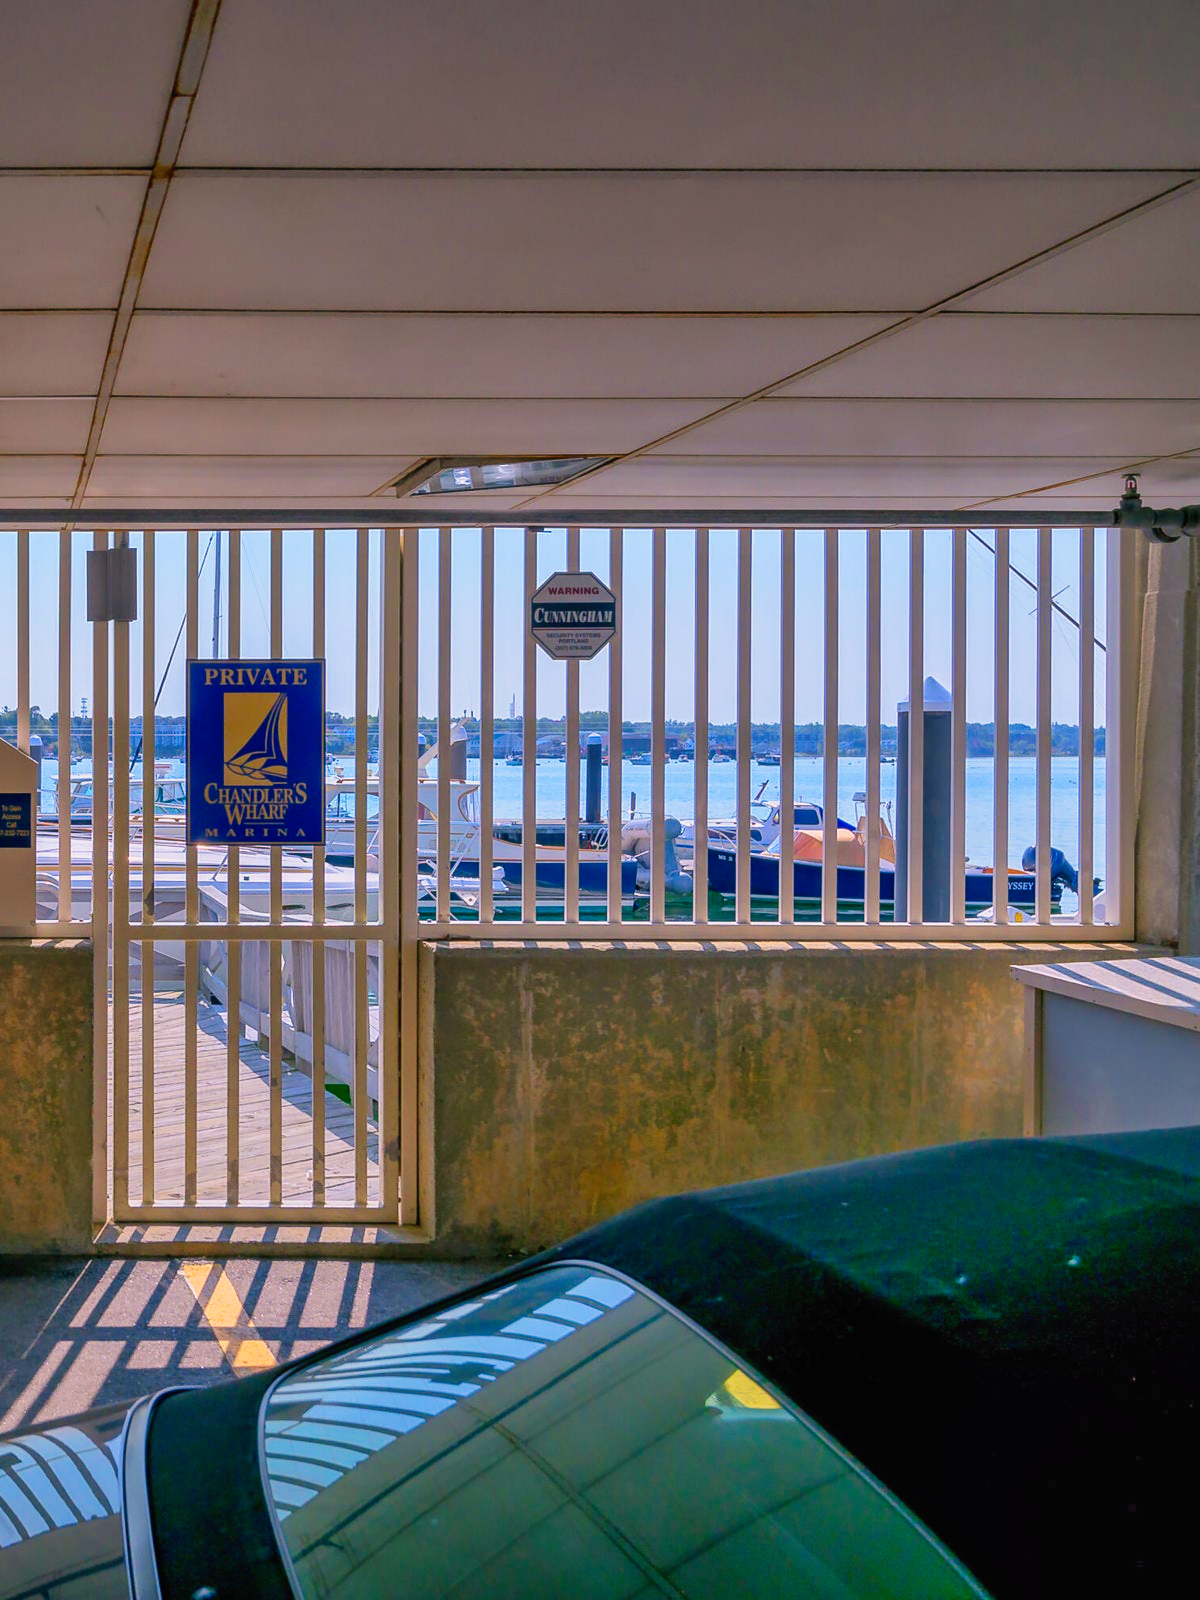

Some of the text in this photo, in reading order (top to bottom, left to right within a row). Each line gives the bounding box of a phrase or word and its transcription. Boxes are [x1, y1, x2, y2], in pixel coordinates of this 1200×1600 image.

[548, 587, 599, 595] WARNING
[534, 607, 613, 623] CUNNINGHAM
[204, 668, 308, 686] PRIVATE
[204, 783, 308, 804] CHANDLER'S
[224, 804, 289, 825] WHARF
[205, 828, 307, 837] MARINA
[1007, 881, 1034, 891] YSSEY
